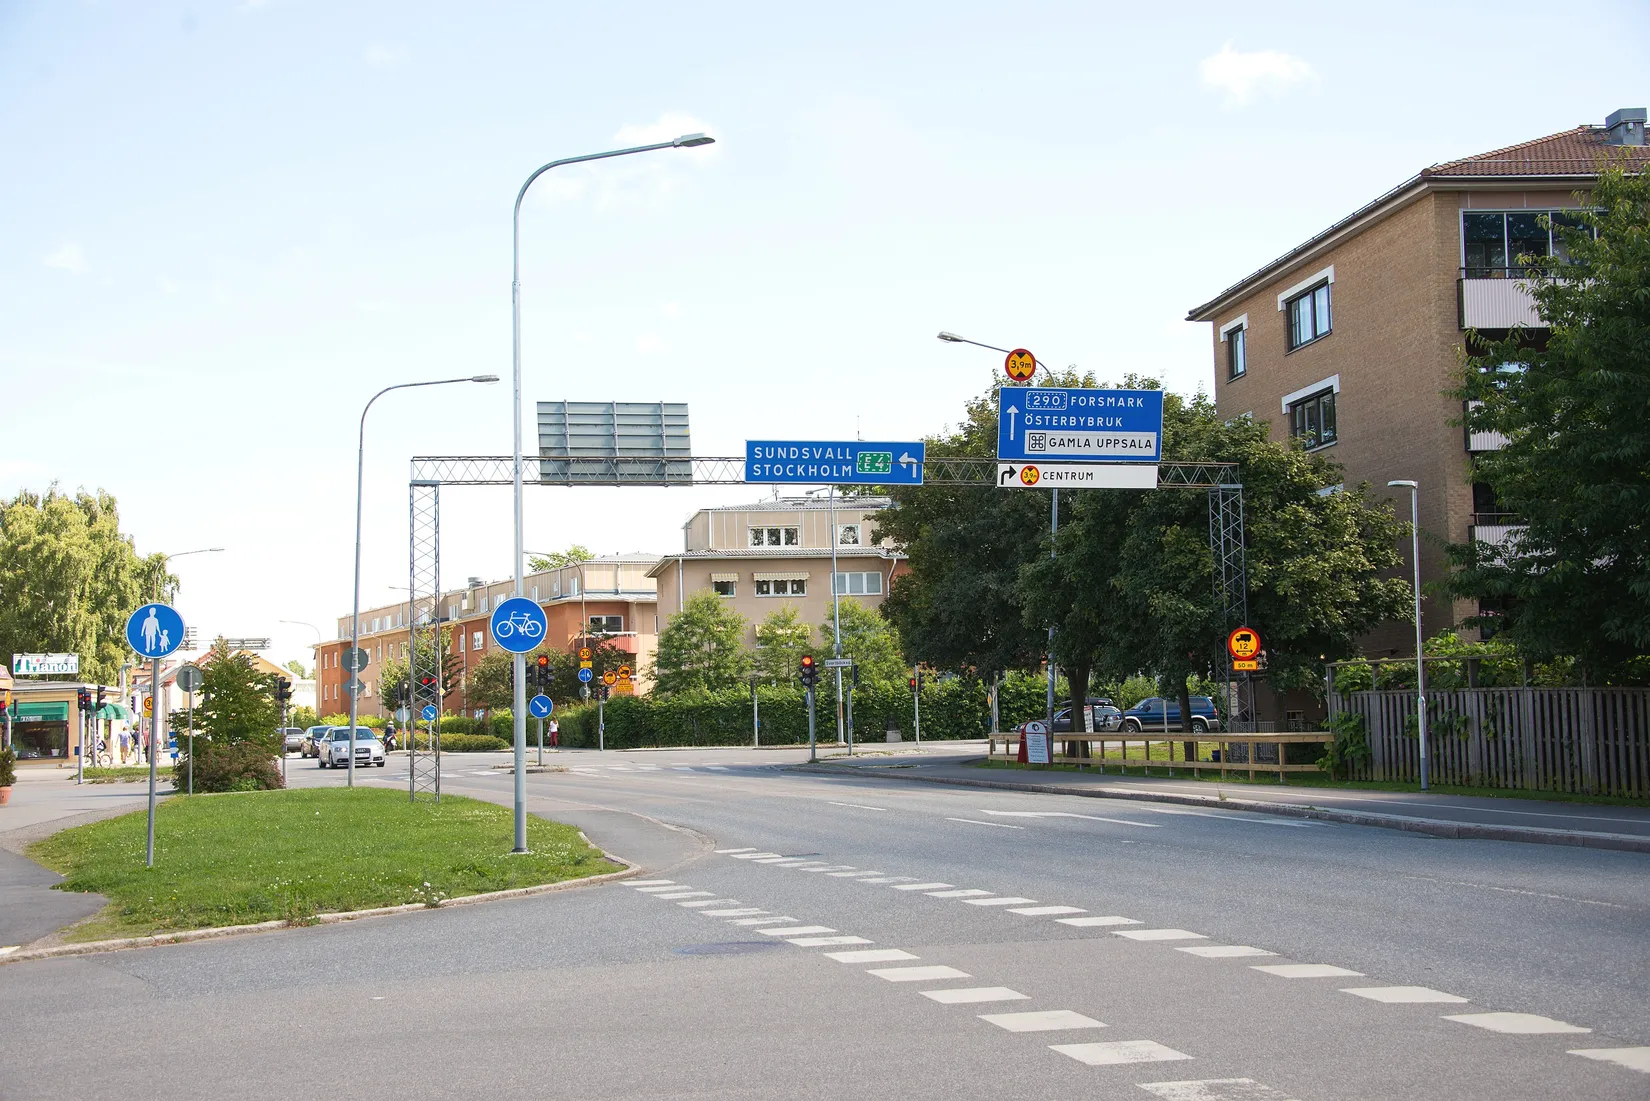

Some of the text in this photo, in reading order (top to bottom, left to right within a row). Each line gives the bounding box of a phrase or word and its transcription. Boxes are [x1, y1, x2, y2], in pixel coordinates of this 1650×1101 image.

[1010, 359, 1032, 370] 3,9m
[1033, 395, 1144, 408] 290 FORSMARK
[1025, 413, 1123, 427] ÖSTERBYBRUK
[1049, 437, 1152, 449] GAMLA UPPSALA
[754, 447, 852, 460] SUNDSVALL
[753, 464, 852, 477] STOCKHOLM
[1042, 471, 1094, 481] CENTRUM
[15, 656, 78, 672] Trianon
